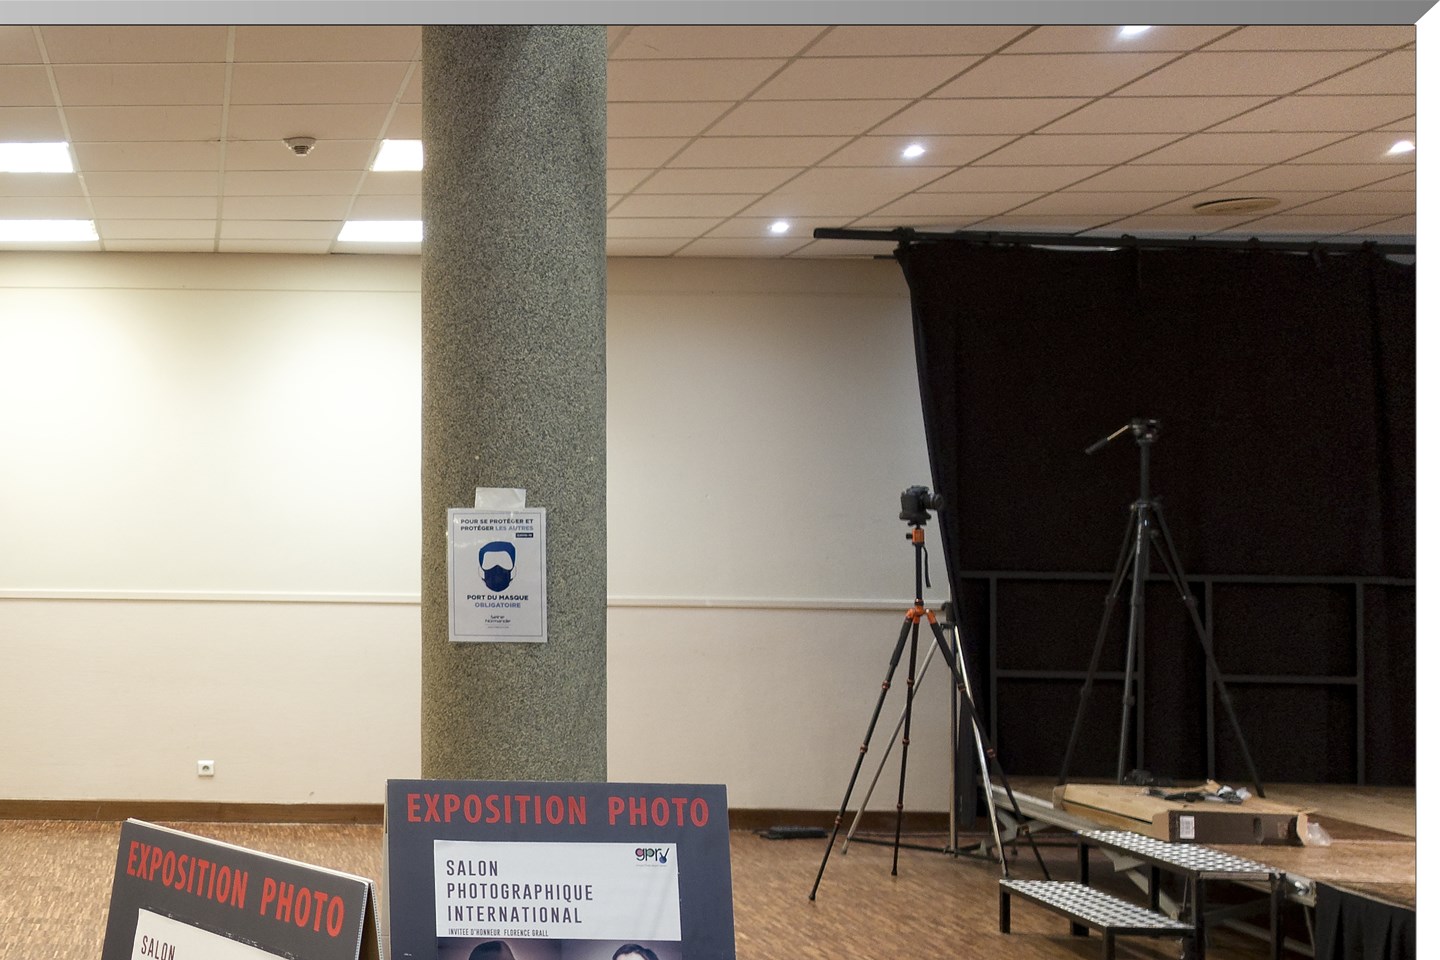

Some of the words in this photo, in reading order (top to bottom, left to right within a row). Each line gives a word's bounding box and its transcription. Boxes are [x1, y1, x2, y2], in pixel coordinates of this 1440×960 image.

[407, 793, 587, 825] EXPOSITION
[608, 796, 709, 827] PHOTO
[446, 859, 499, 877] SALON
[126, 840, 249, 909] EXPOSITION
[260, 877, 345, 937] PHOTO
[447, 883, 594, 903] PHOTOGRAPHIQUE
[448, 905, 582, 924] INTERNATIONAL
[448, 928, 469, 936] INVITEE
[470, 928, 501, 936] D'HONNEUR
[503, 928, 530, 937] FLORENCE
[531, 929, 549, 937] GRALL
